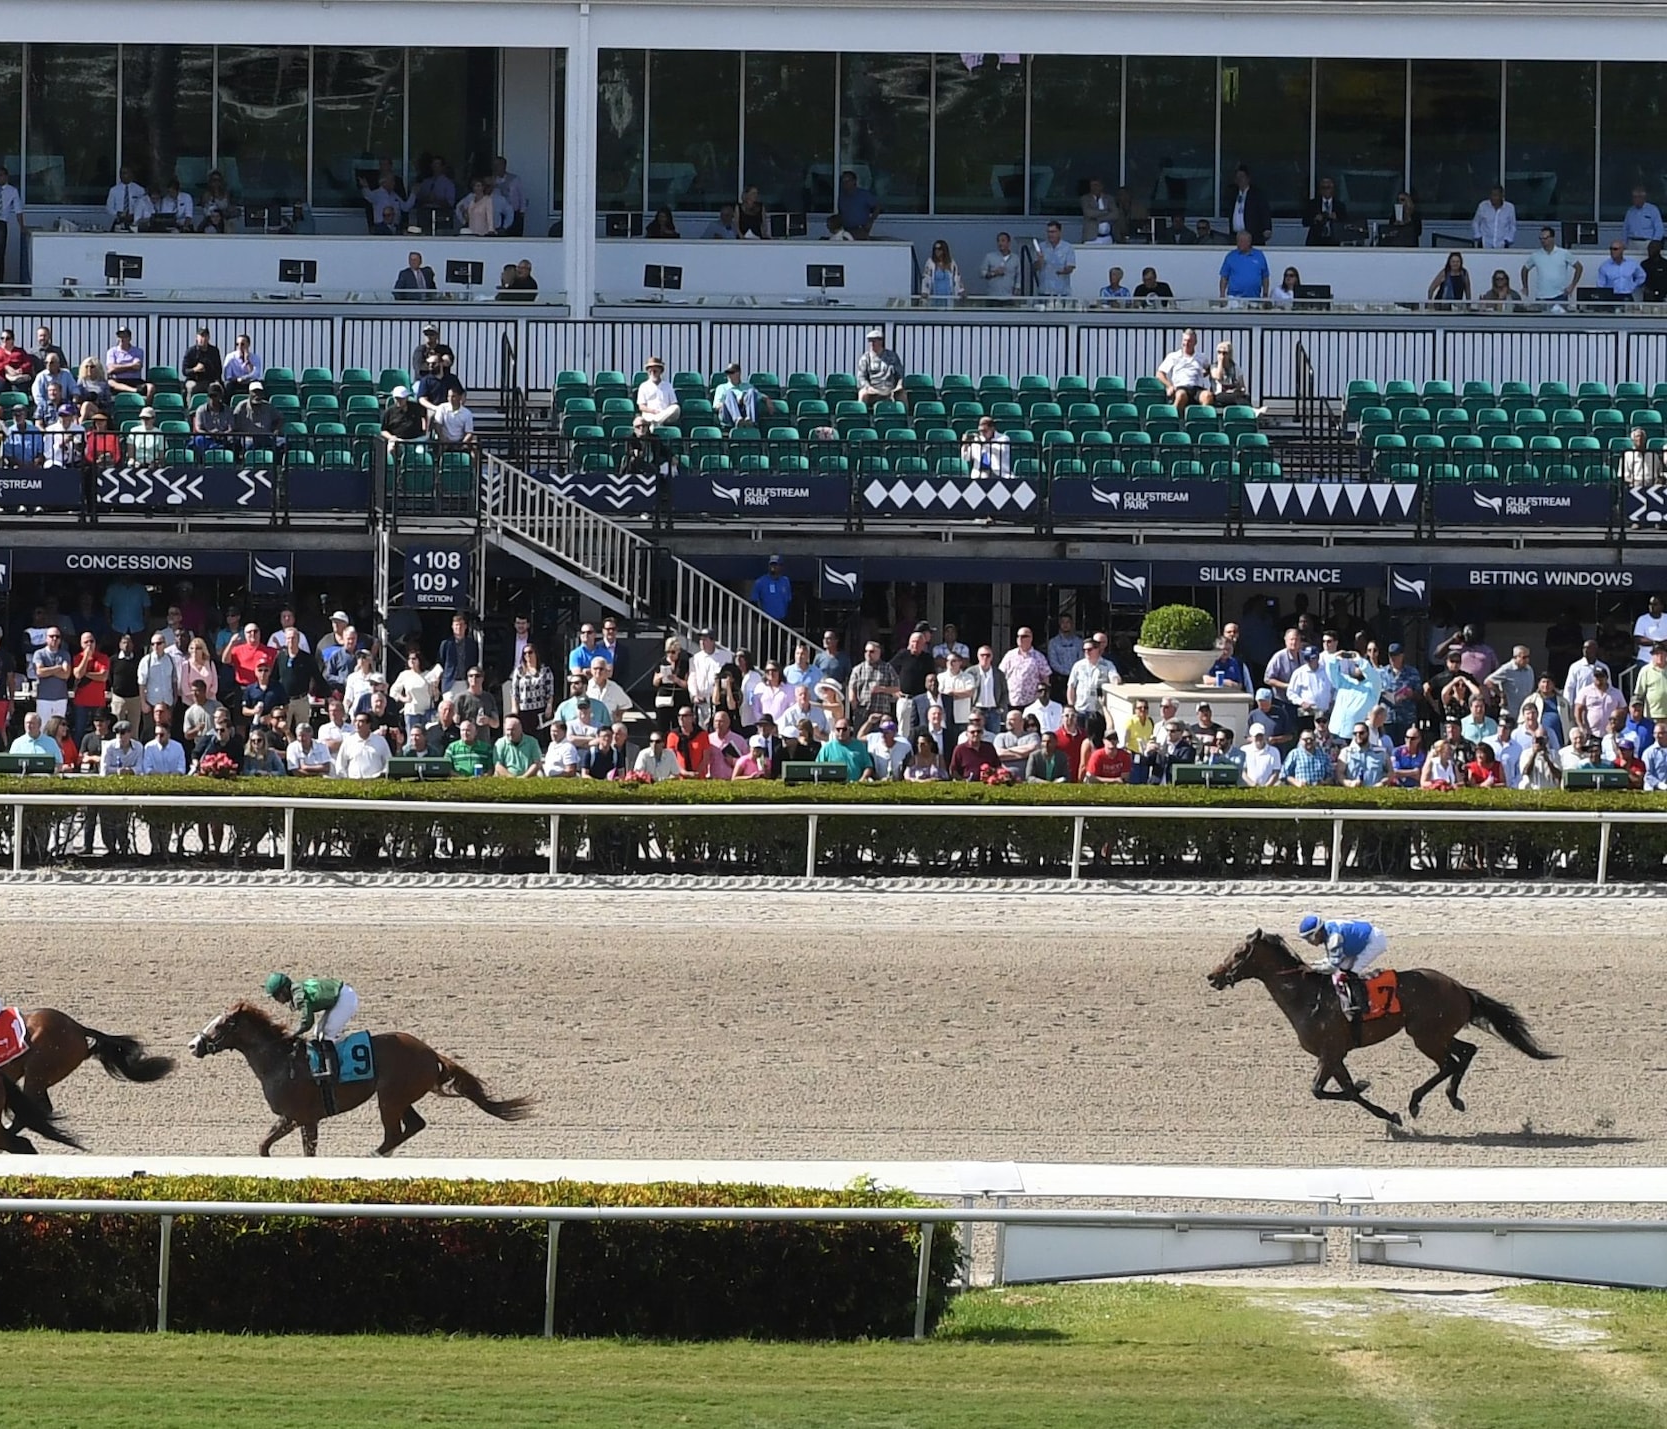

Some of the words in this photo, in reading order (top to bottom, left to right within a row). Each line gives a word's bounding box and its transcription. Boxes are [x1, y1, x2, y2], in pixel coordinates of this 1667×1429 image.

[744, 487, 809, 498] GULFSTREAM
[1124, 491, 1189, 502] GULFSTREAM
[744, 497, 769, 506] PARK
[1124, 501, 1149, 510] PARK
[1506, 496, 1571, 507] GULFSTREAM
[1506, 506, 1531, 515] PARK
[66, 554, 193, 571] CONCESSIONS
[426, 551, 461, 570] 108
[1199, 567, 1246, 582] SILKS
[1252, 567, 1341, 583] ENTRANCE
[1469, 570, 1539, 587] BETTING
[1544, 571, 1633, 587] WINDOWS
[412, 572, 447, 592] 109
[417, 593, 454, 603] SECTION
[1377, 985, 1395, 1011] 7
[351, 1043, 371, 1075] 9
